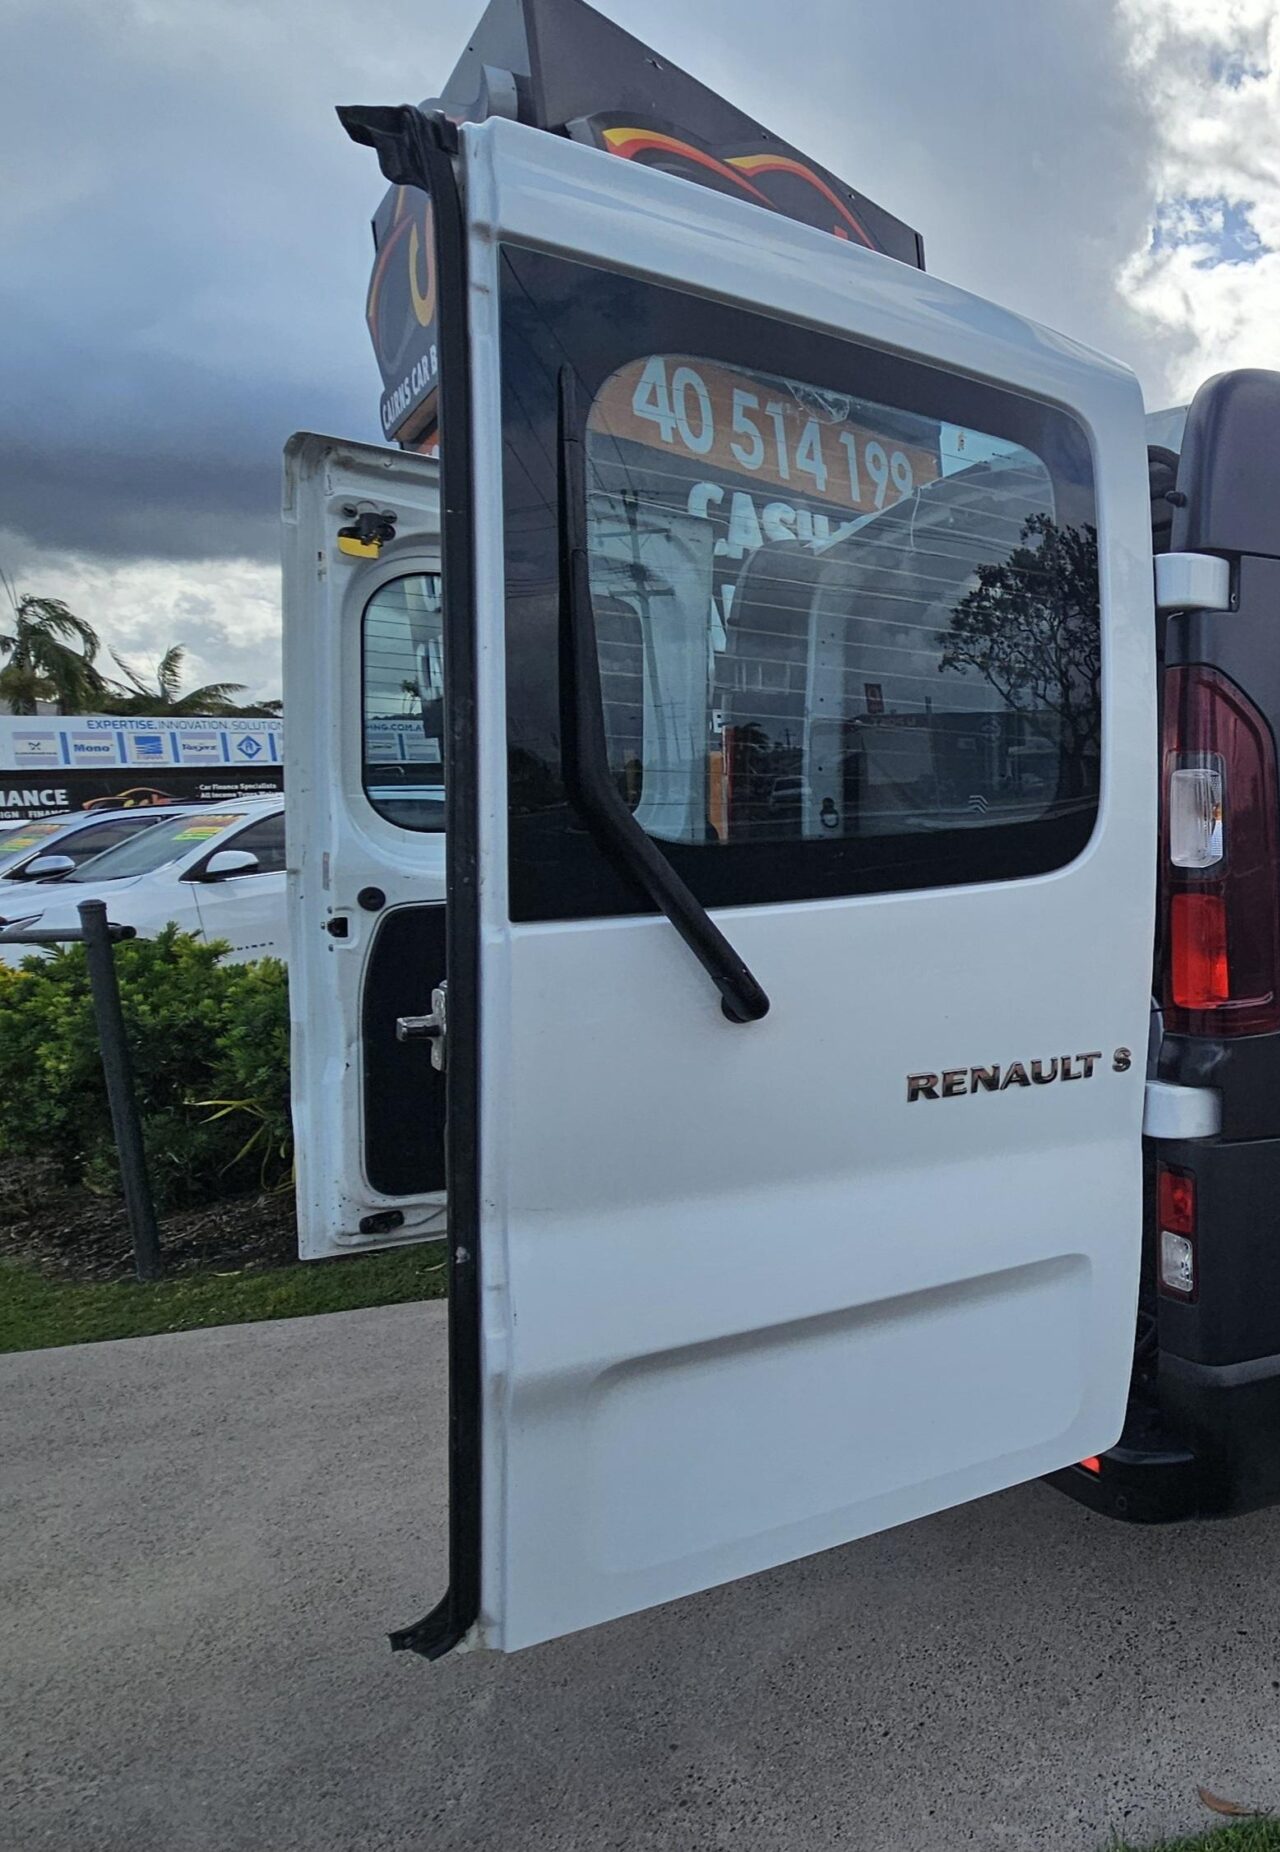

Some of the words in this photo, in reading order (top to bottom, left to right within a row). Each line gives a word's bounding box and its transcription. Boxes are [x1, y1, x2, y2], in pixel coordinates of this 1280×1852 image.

[382, 377, 411, 431] CAIRNS
[411, 355, 430, 395] CAR
[632, 355, 714, 455] 40
[730, 387, 828, 492] 514
[839, 430, 913, 510] 199
[199, 783, 211, 791] Car
[240, 782, 277, 790] Specialists
[906, 1050, 1102, 1103] RENAULT
[1112, 1046, 1131, 1073] S
